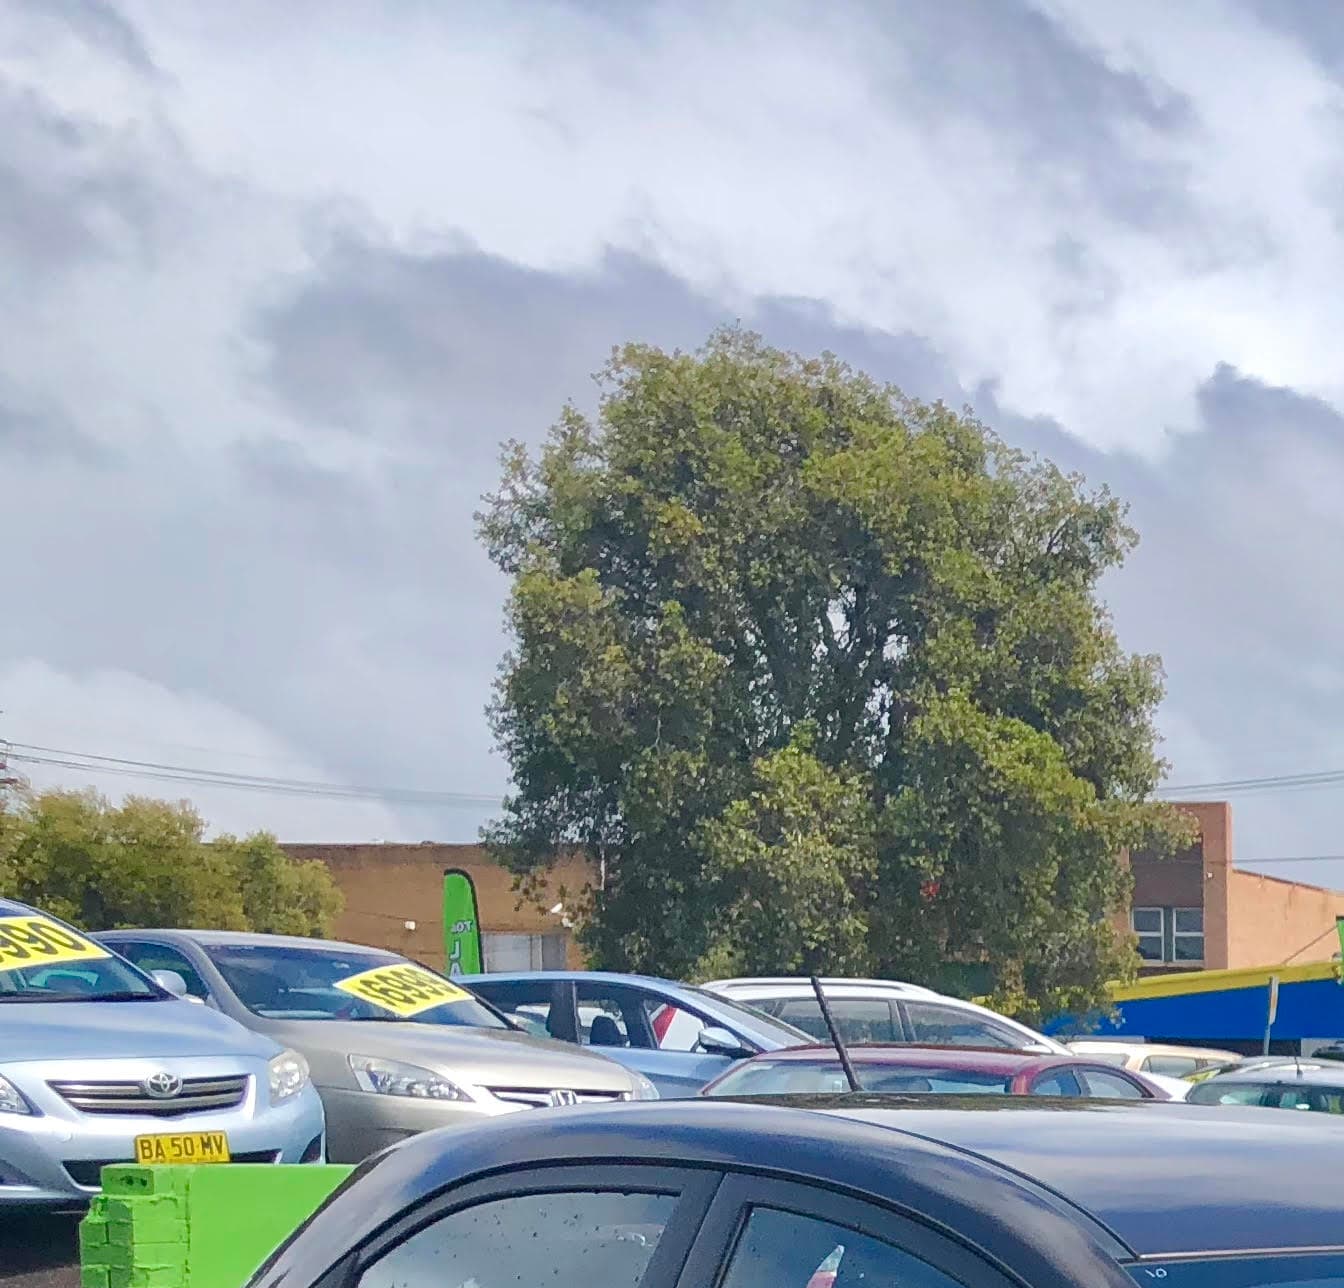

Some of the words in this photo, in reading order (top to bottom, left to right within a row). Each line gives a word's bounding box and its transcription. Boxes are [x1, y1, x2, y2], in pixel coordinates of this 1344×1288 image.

[140, 1139, 165, 1159] BA
[170, 1136, 195, 1157] 50
[200, 1135, 223, 1155] MV
